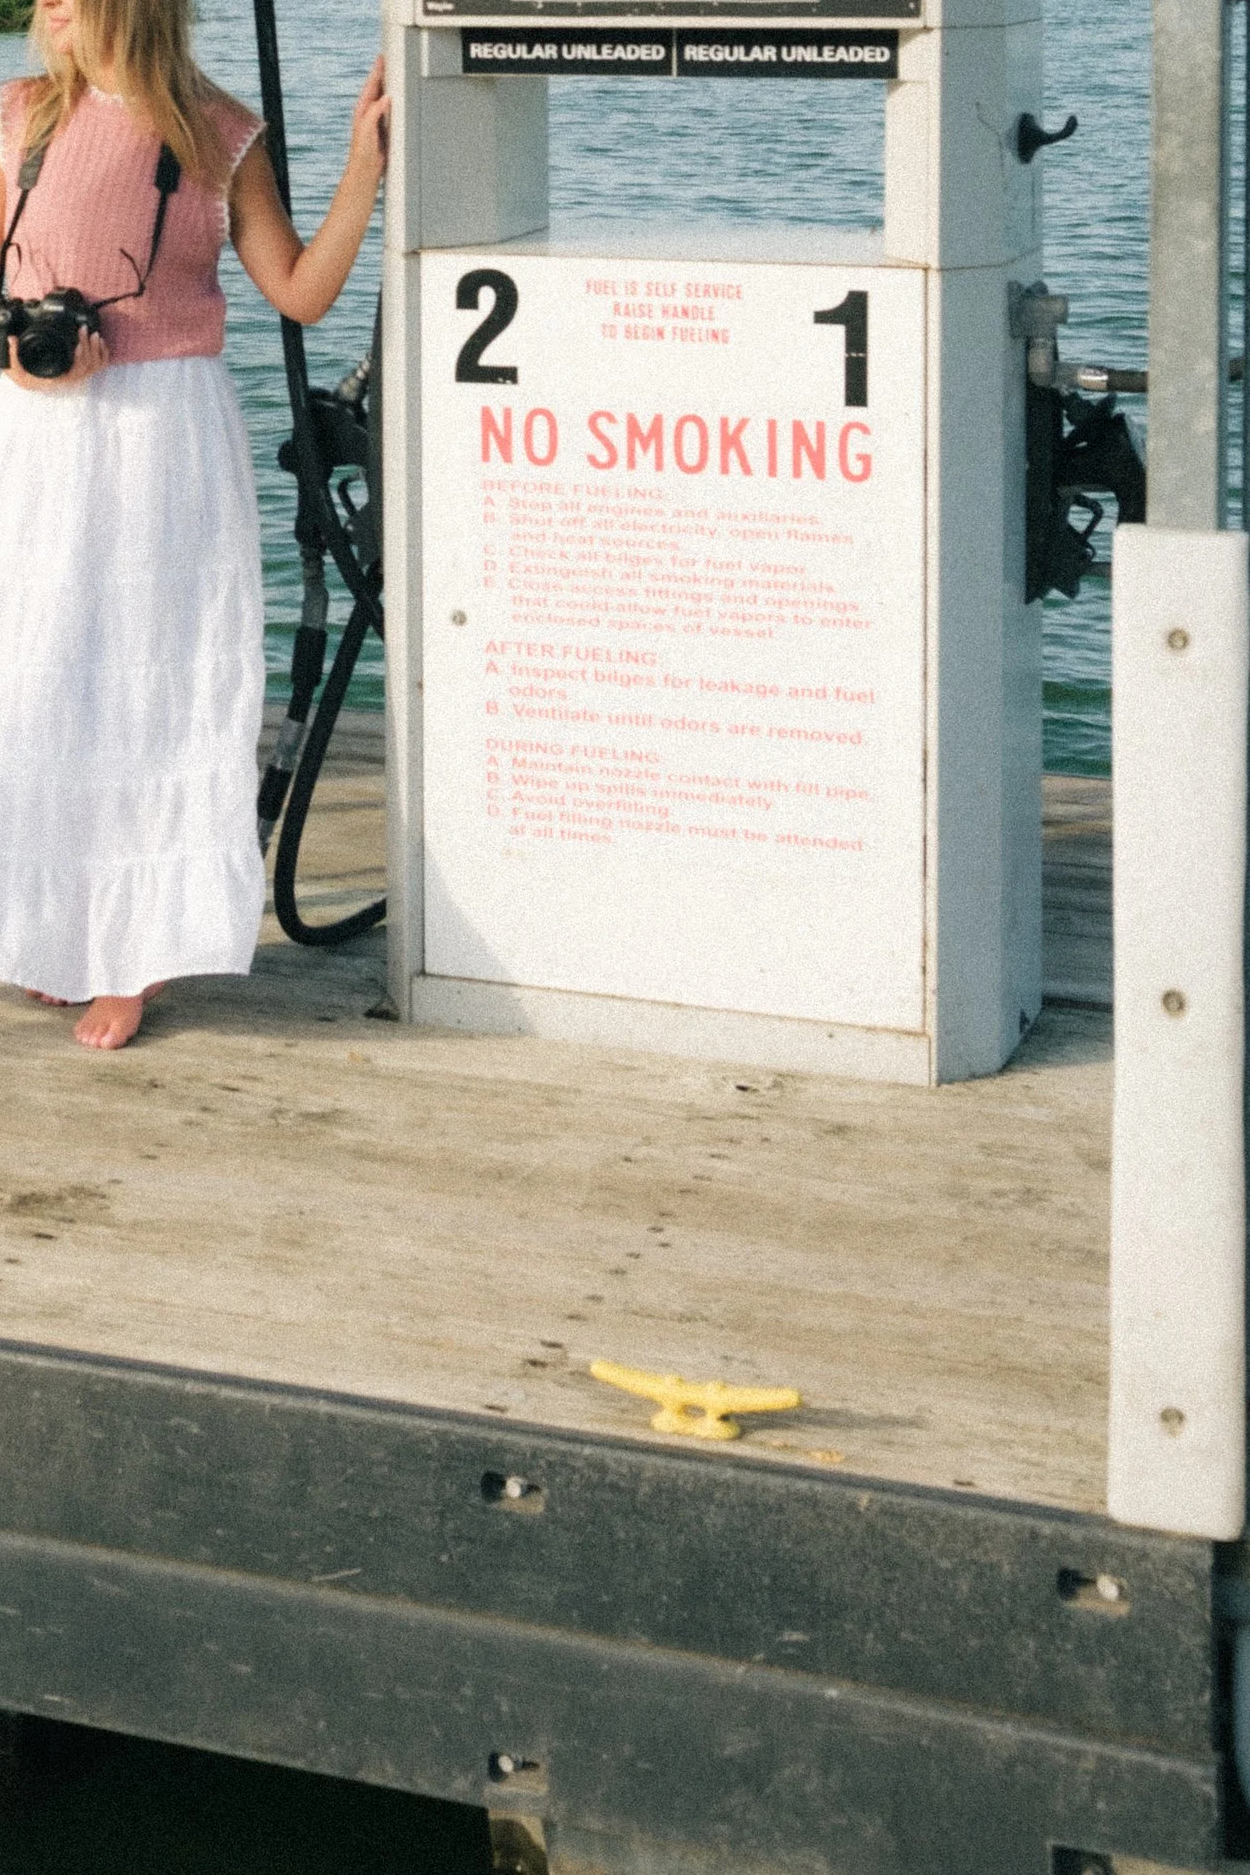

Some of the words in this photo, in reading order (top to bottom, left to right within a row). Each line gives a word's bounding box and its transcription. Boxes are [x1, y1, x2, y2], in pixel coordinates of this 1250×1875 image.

[469, 42, 558, 61] REGULAR
[562, 42, 665, 62] UNLEADED
[684, 44, 774, 63] REGULAR
[778, 44, 891, 64] UNLEADED
[585, 279, 617, 295] FUEL
[624, 280, 638, 296] IS
[645, 280, 677, 297] SELF
[685, 281, 743, 300] SERVICE
[612, 300, 653, 319] RAISE
[661, 303, 715, 322] HANDLE
[454, 268, 519, 385] 2
[600, 323, 617, 339] TO
[624, 324, 665, 341] BEGIN
[670, 325, 730, 345] FUELING
[813, 289, 869, 408] 1
[480, 405, 559, 466] NO
[586, 409, 874, 482] SMOKING
[481, 479, 564, 495] BEFORE
[509, 497, 552, 512] Stop
[559, 501, 581, 512] all
[587, 504, 664, 517] engines
[674, 508, 708, 519] and
[509, 513, 553, 526] Shut
[559, 516, 586, 526] off
[592, 519, 614, 530] all
[729, 528, 779, 541] open
[511, 531, 546, 542] and
[552, 532, 594, 545] heat
[509, 545, 568, 560] Check
[577, 552, 600, 562] all
[606, 553, 663, 568] bilges
[671, 555, 696, 567] for
[705, 557, 742, 570] fuel
[509, 561, 613, 580] Extinguish
[620, 570, 643, 581] all
[651, 573, 735, 589] smoking
[508, 577, 563, 592] Close
[570, 584, 637, 597] access
[644, 587, 713, 604] fittings
[722, 594, 758, 606] and
[766, 597, 860, 613] openings
[511, 595, 548, 607] that
[555, 600, 609, 613] could
[616, 603, 666, 616] allow
[674, 605, 711, 618] fuel
[719, 611, 785, 625] vapors
[793, 614, 812, 626] to
[820, 617, 871, 630] enter
[511, 613, 600, 627] enclosed
[607, 620, 675, 633] spaces
[682, 622, 702, 634] of
[485, 640, 555, 658] AFTER
[512, 662, 586, 682] Inspect
[593, 669, 655, 688] bilges
[663, 674, 691, 689] for
[699, 676, 780, 700] leakage
[789, 686, 828, 700] and
[834, 686, 875, 703] fuel
[512, 703, 600, 723] Ventilate
[607, 712, 652, 727] until
[661, 717, 720, 733] odors
[727, 724, 761, 737] are
[486, 737, 564, 755] DURING
[512, 757, 592, 774] Maintain
[599, 766, 661, 781] nozzle
[668, 774, 740, 788] contact
[748, 780, 789, 793] with
[795, 782, 820, 796] fill
[512, 775, 559, 789] Wipe
[565, 781, 590, 793] up
[595, 784, 647, 797] spills
[512, 791, 566, 806] Avoid
[509, 825, 526, 836] at
[534, 827, 553, 838] all
[512, 807, 553, 821] Fuel
[559, 812, 613, 830] filling
[619, 819, 680, 834] nozzle
[688, 825, 737, 838] must
[743, 829, 768, 841] be
[776, 832, 863, 852] attended
